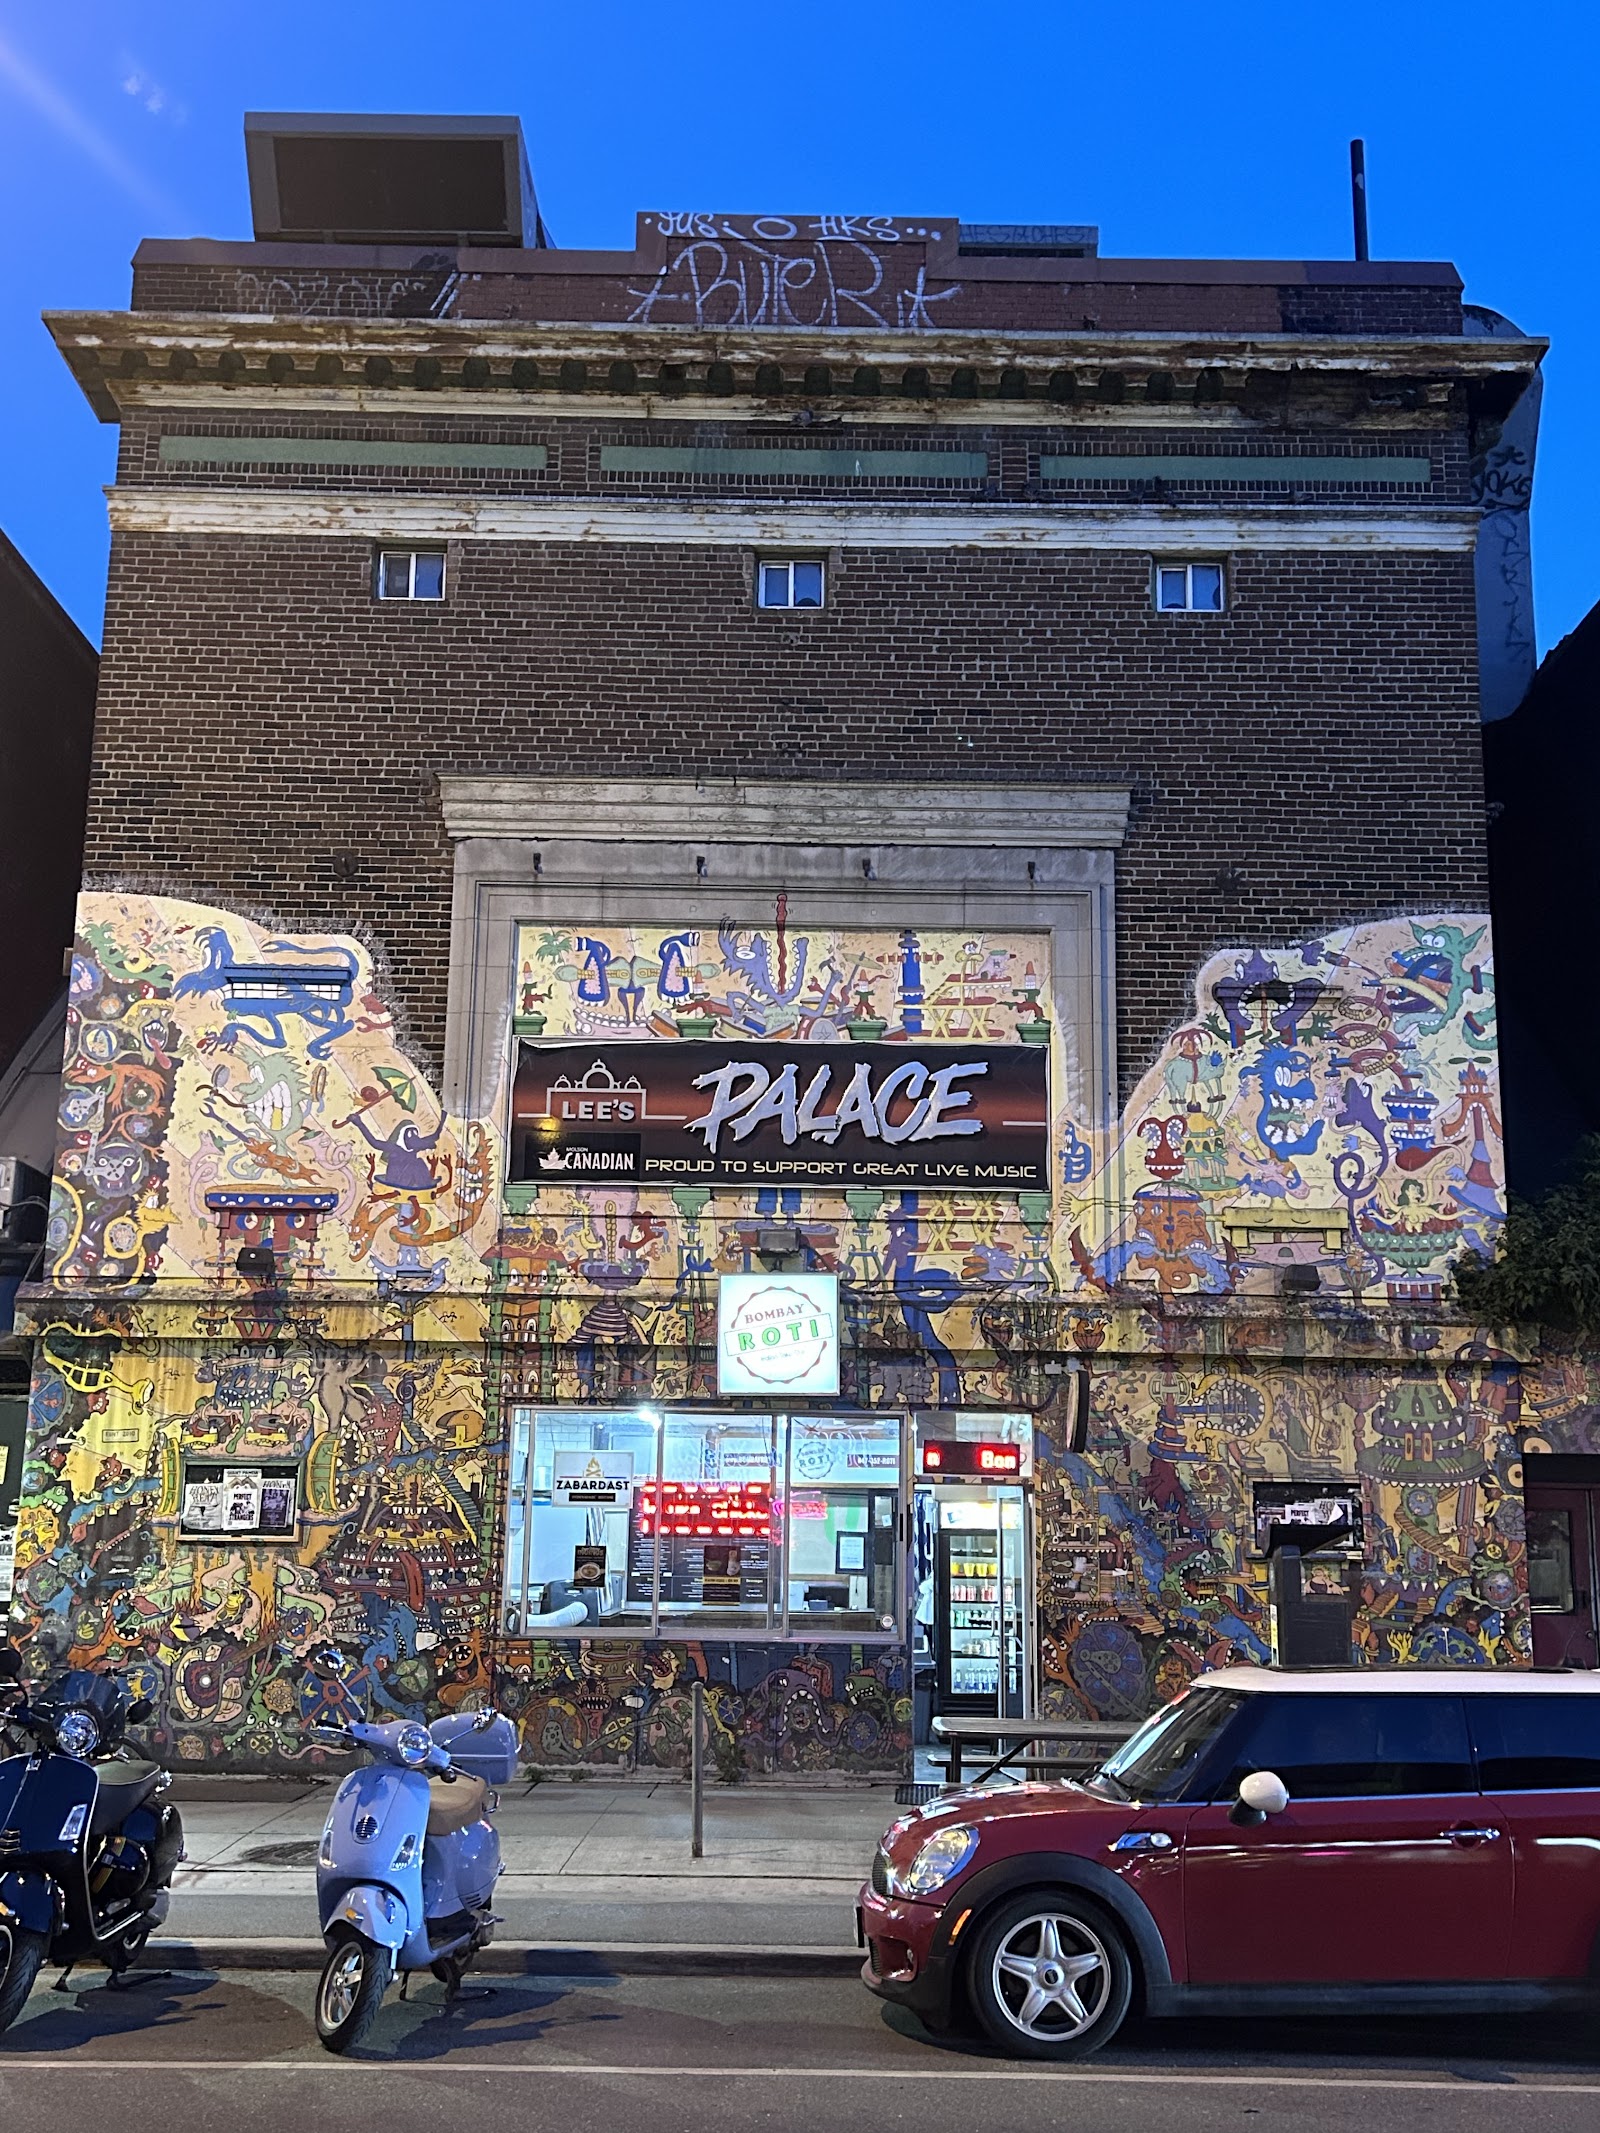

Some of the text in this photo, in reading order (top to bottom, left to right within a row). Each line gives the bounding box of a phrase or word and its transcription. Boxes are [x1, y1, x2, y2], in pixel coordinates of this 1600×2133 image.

[561, 1098, 636, 1122] LEE'S
[683, 1059, 989, 1154] PALACE
[565, 1153, 634, 1171] CANADIAN
[645, 1159, 1037, 1179] PROUD TO SUPPORT GREAT LIVE MUSIC
[744, 1303, 805, 1325] BOMBAY
[737, 1319, 819, 1352] ROTI
[799, 1454, 830, 1468] ROTI
[556, 1480, 630, 1491] ZABARDAST
[1290, 1509, 1310, 1517] PERFECT
